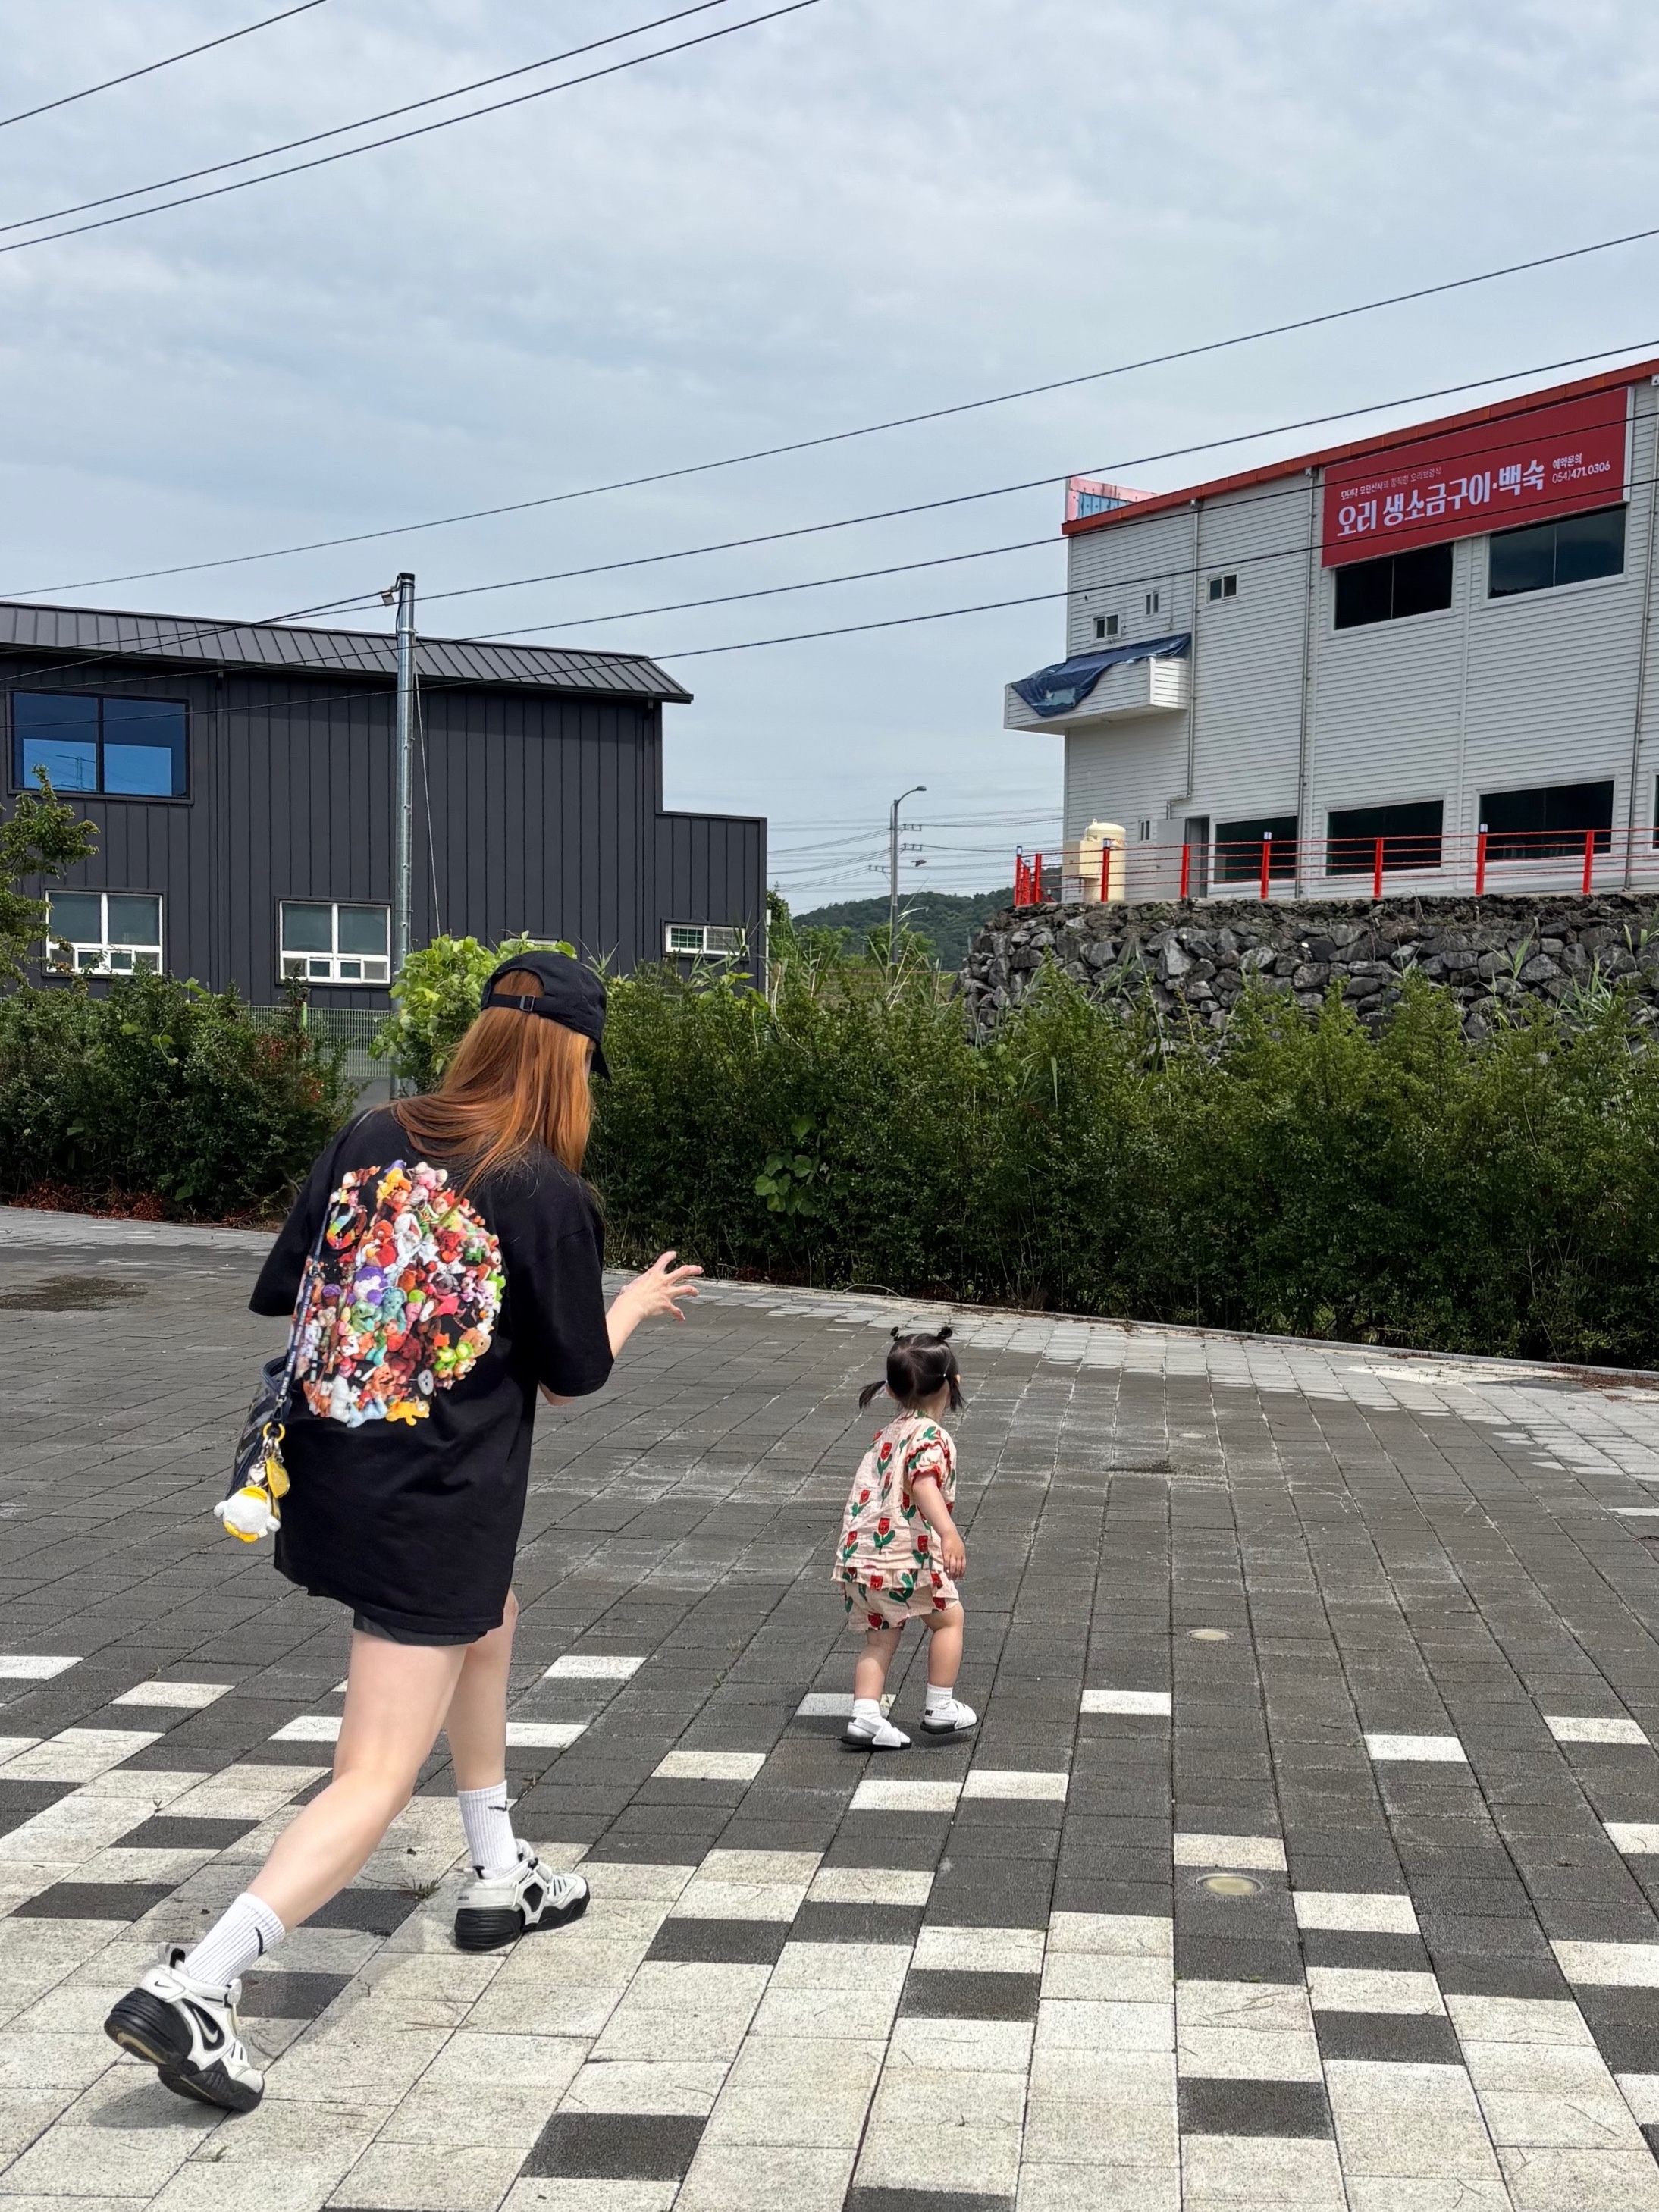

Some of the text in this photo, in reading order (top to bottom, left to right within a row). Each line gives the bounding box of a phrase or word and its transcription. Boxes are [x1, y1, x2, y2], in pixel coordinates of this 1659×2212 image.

[1551, 460, 1611, 484] 054)471.0306
[1552, 453, 1582, 469] 예약문의
[1337, 460, 1545, 536] 오리 생소금구이·백숙
